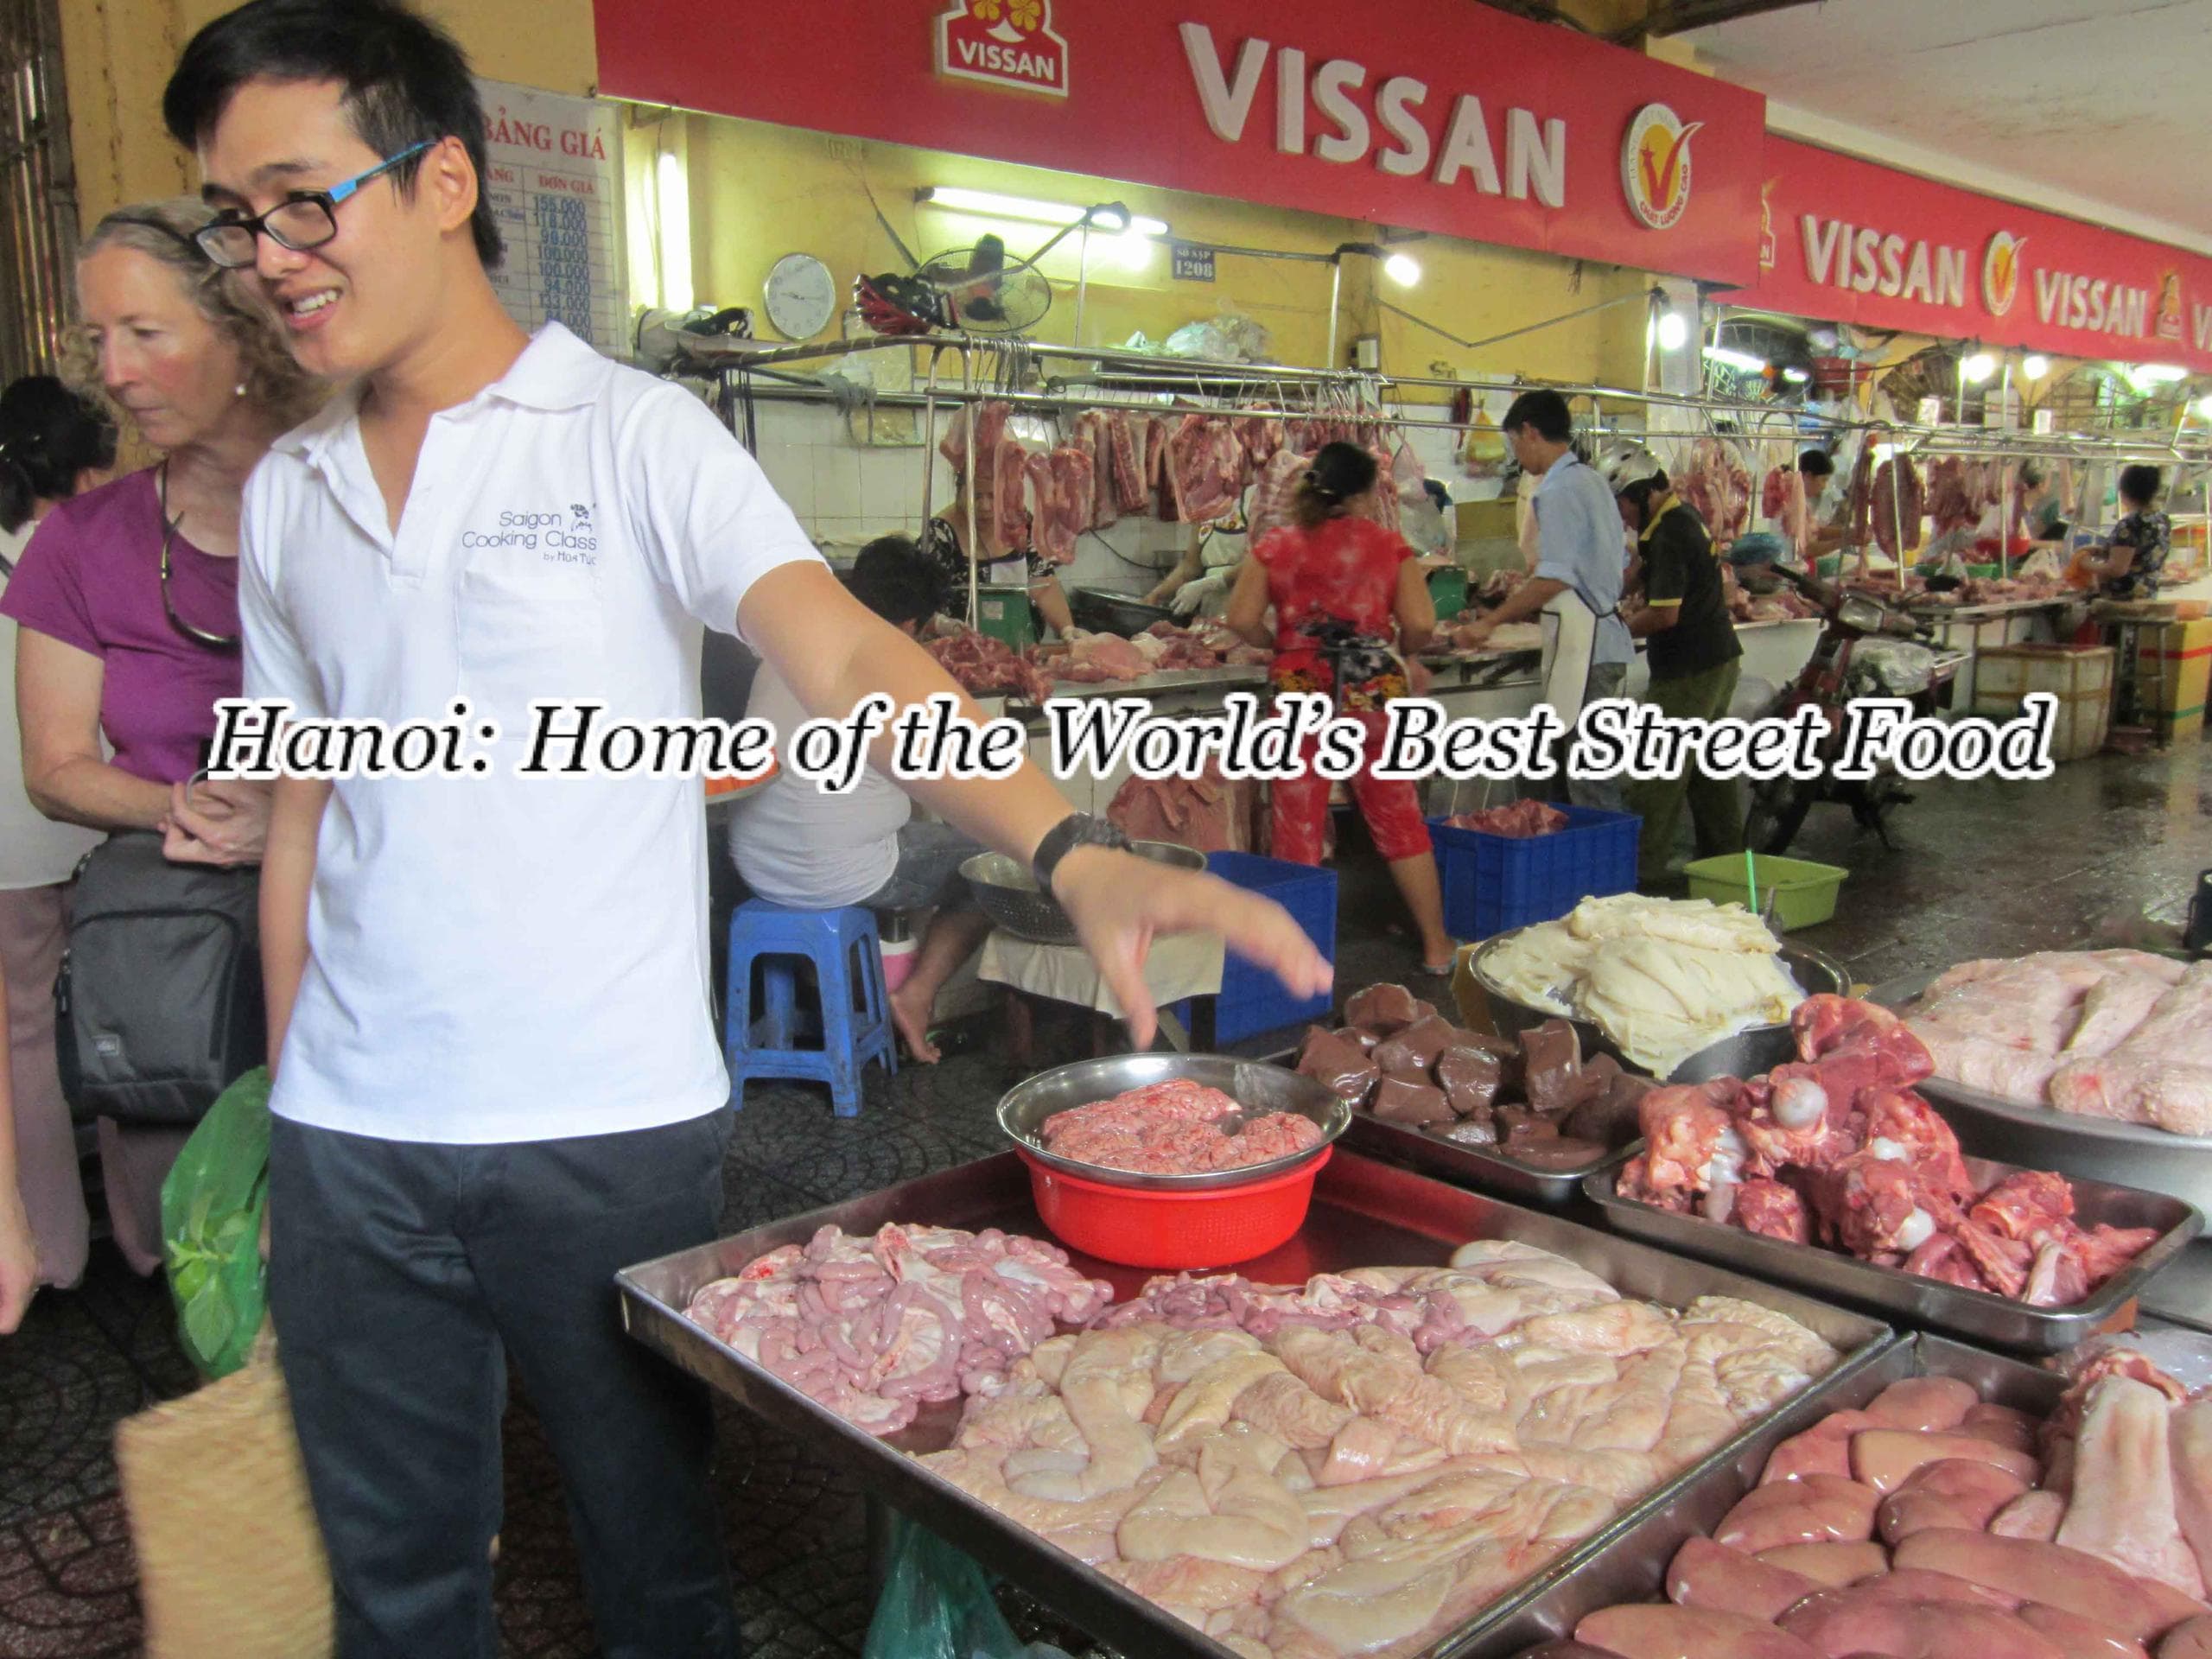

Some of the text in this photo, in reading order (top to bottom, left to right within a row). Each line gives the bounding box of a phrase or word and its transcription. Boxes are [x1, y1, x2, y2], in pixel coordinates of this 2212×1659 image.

[957, 38, 1054, 80] VISSAN
[1179, 22, 1565, 207] VISSAN
[560, 128, 606, 161] GIÁ
[1176, 260, 1213, 277] 1208
[1801, 213, 1967, 308] VISSAN
[2034, 268, 2148, 338] VISSAN
[499, 511, 562, 530] Saigon
[462, 530, 598, 550] Cooking Class
